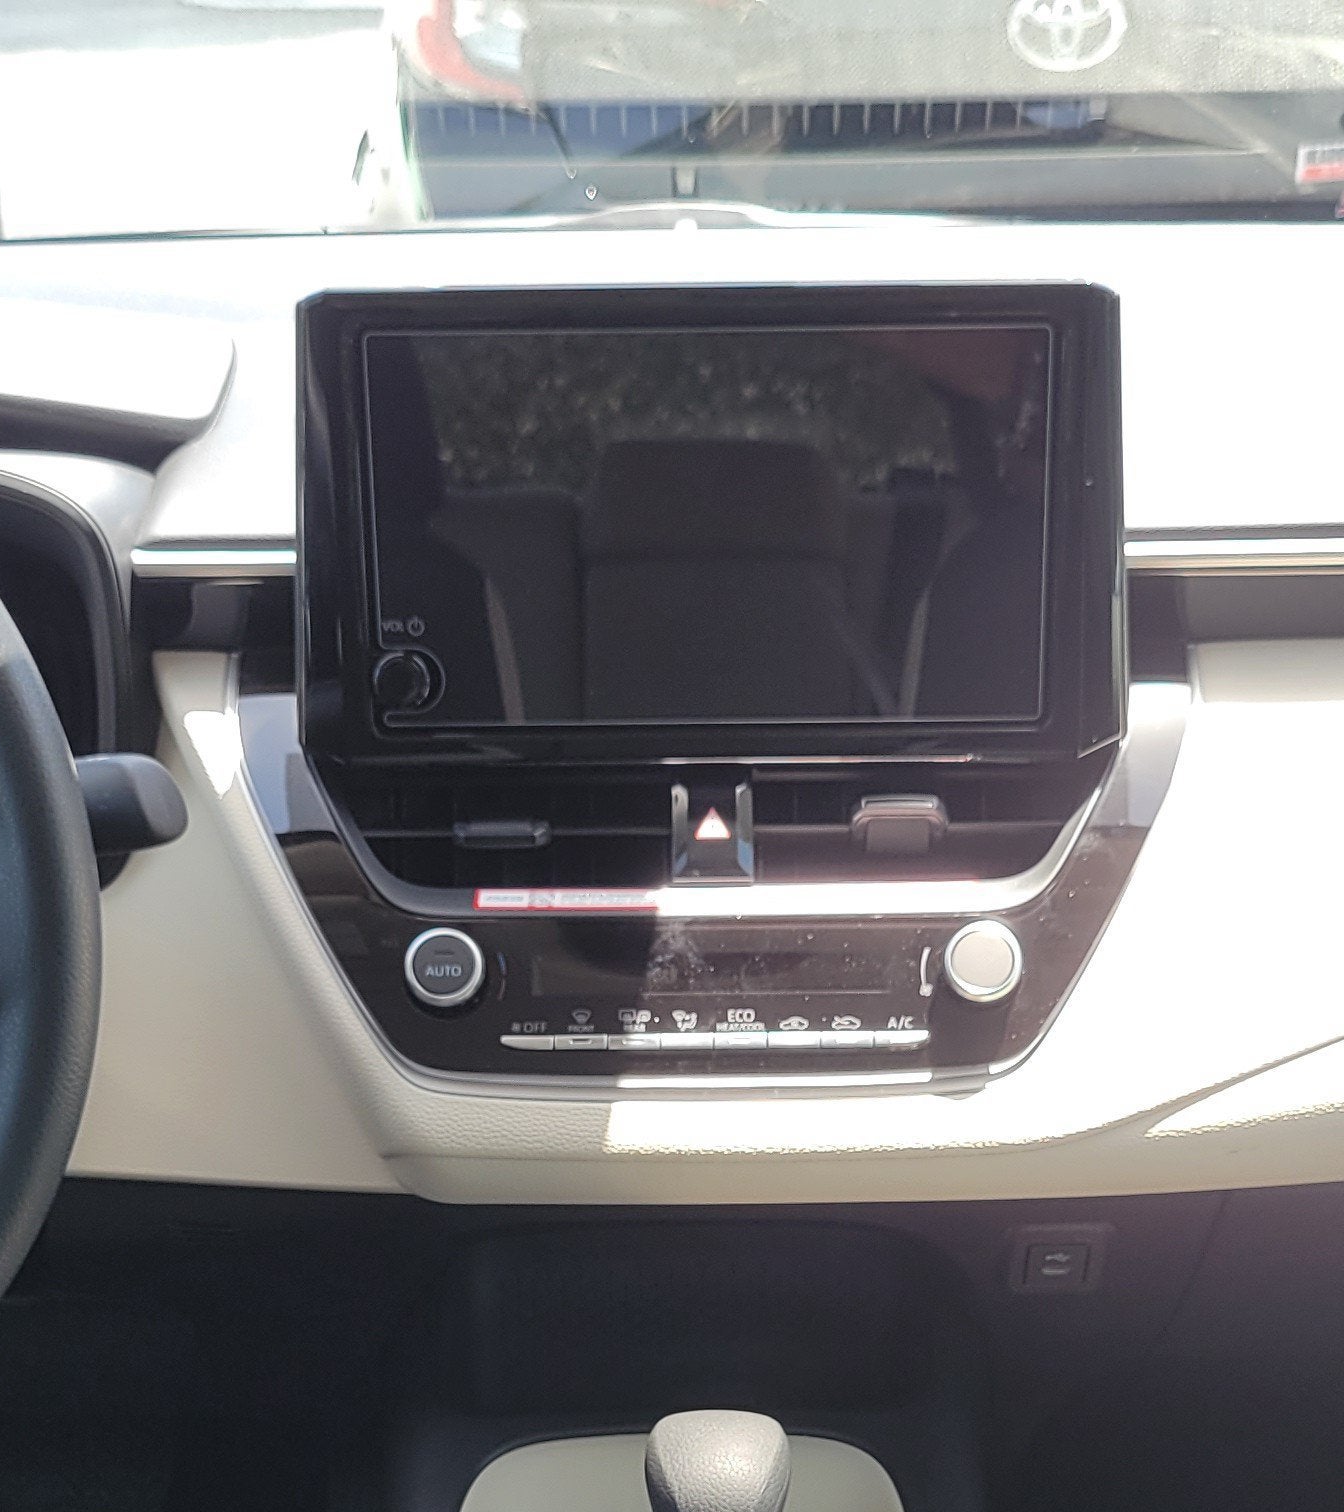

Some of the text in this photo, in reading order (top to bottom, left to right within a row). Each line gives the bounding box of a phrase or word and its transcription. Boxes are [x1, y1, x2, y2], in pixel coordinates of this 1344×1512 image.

[425, 964, 462, 977] AUTO
[727, 1008, 755, 1023] ECO
[887, 1015, 914, 1030] A/C
